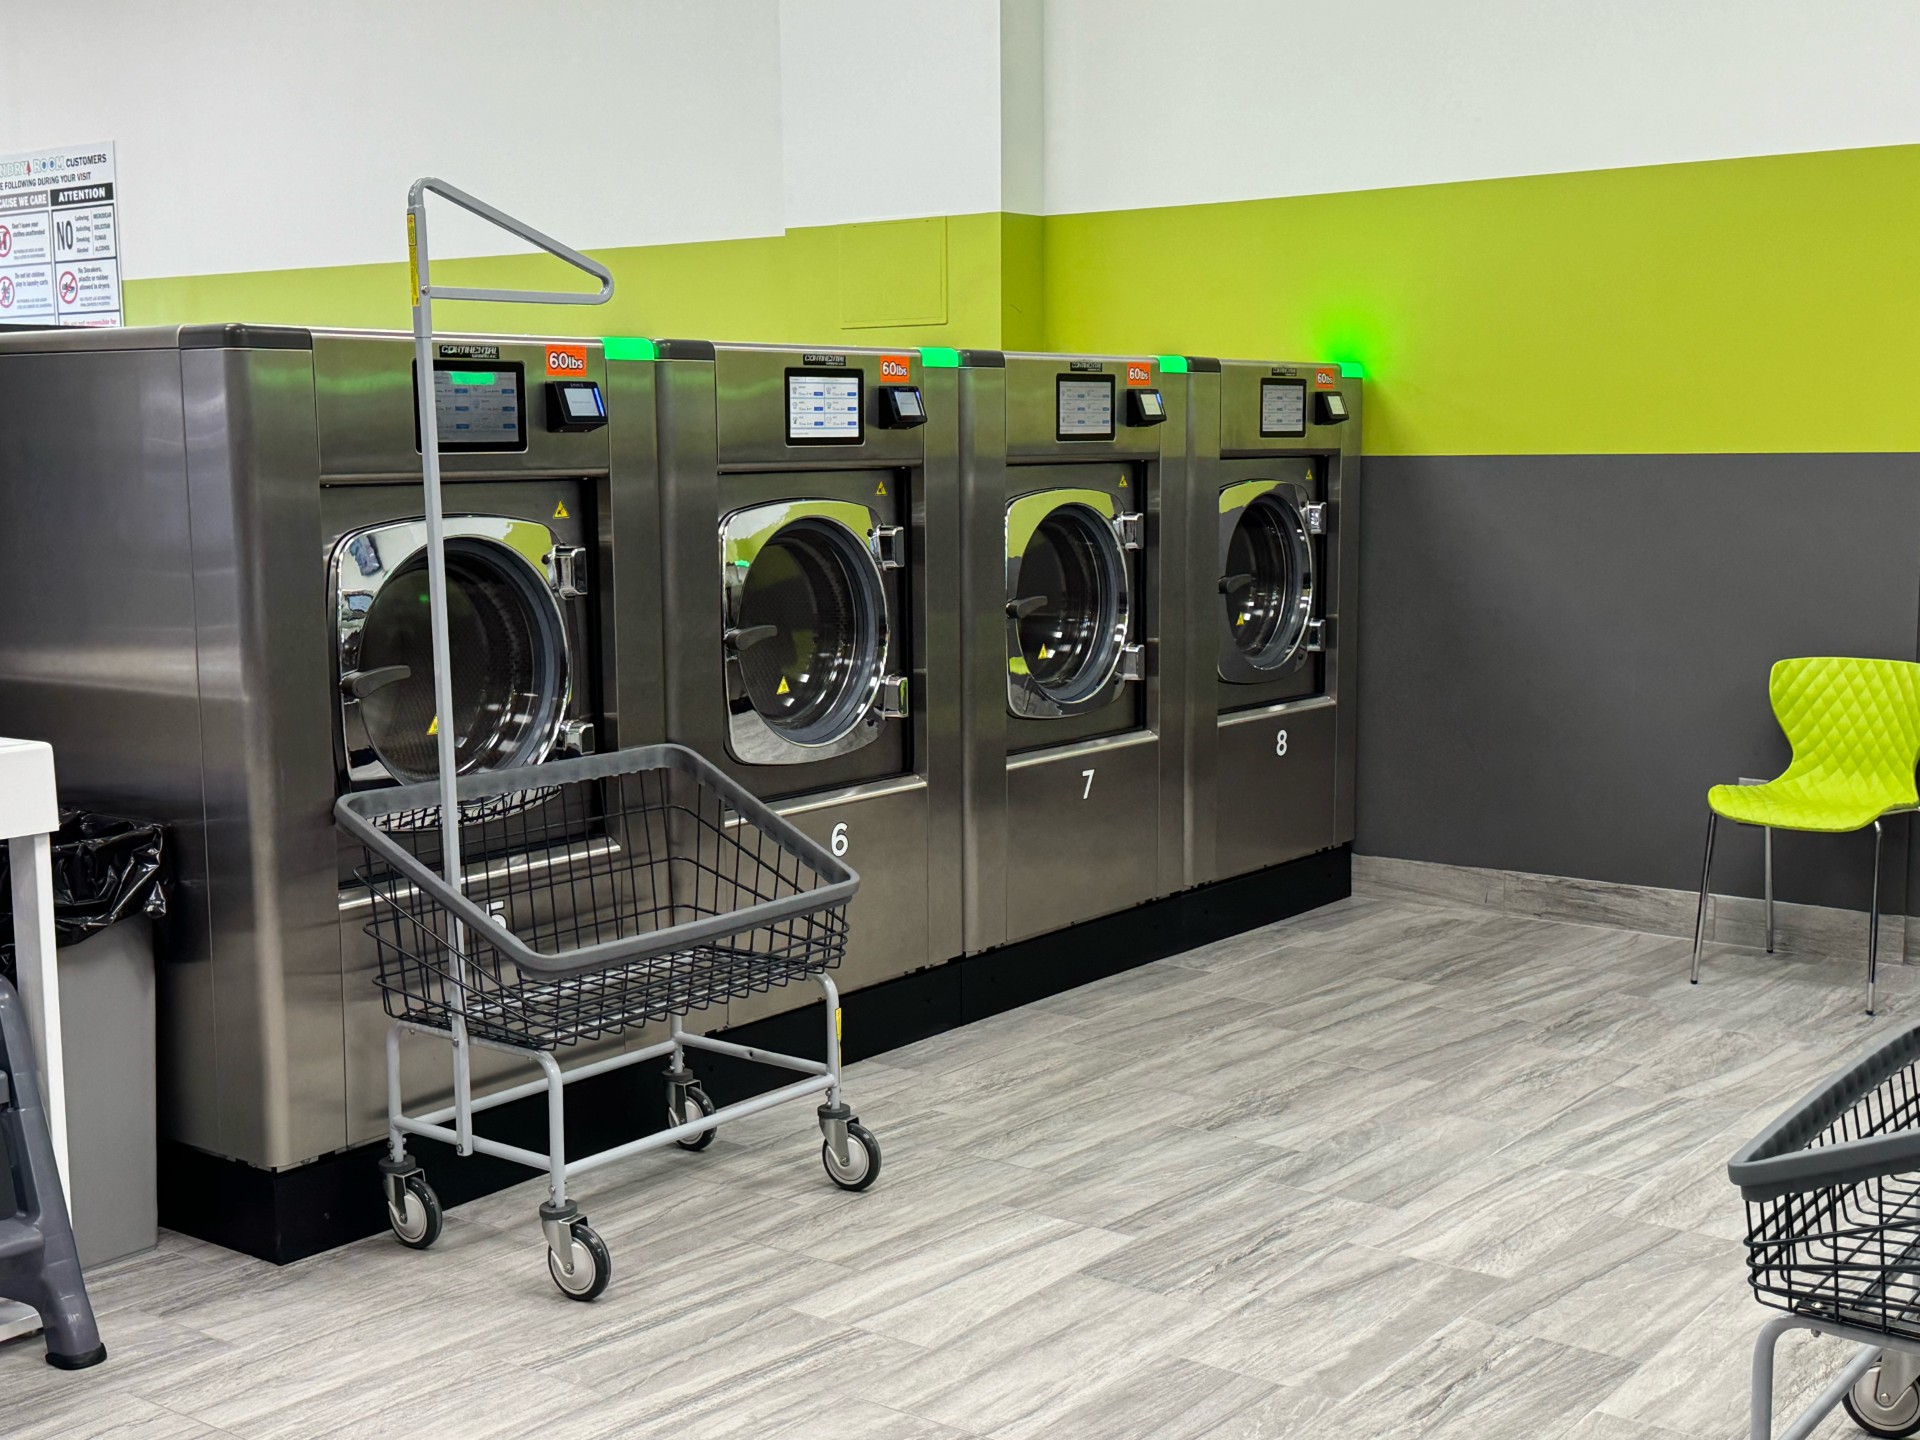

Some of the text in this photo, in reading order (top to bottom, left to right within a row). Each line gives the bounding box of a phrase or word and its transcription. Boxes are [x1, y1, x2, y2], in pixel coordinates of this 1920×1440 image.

[33, 156, 65, 174] ROOM
[66, 153, 107, 168] CUSTOMERS
[5, 179, 36, 190] FOLLOWING
[38, 175, 60, 186] DURING
[60, 174, 76, 183] YOUR
[77, 171, 91, 181] VISIT
[18, 195, 29, 207] WE
[30, 193, 47, 206] CARE
[58, 186, 106, 203] ATTENTION
[56, 220, 74, 251] NO
[548, 351, 584, 370] 60lbs
[881, 361, 908, 376] 60lbs
[1129, 367, 1149, 381] 60lbs
[1317, 371, 1333, 384] 60lbs
[1276, 729, 1288, 757] 8
[1082, 768, 1095, 799] 7
[831, 822, 849, 857] 6
